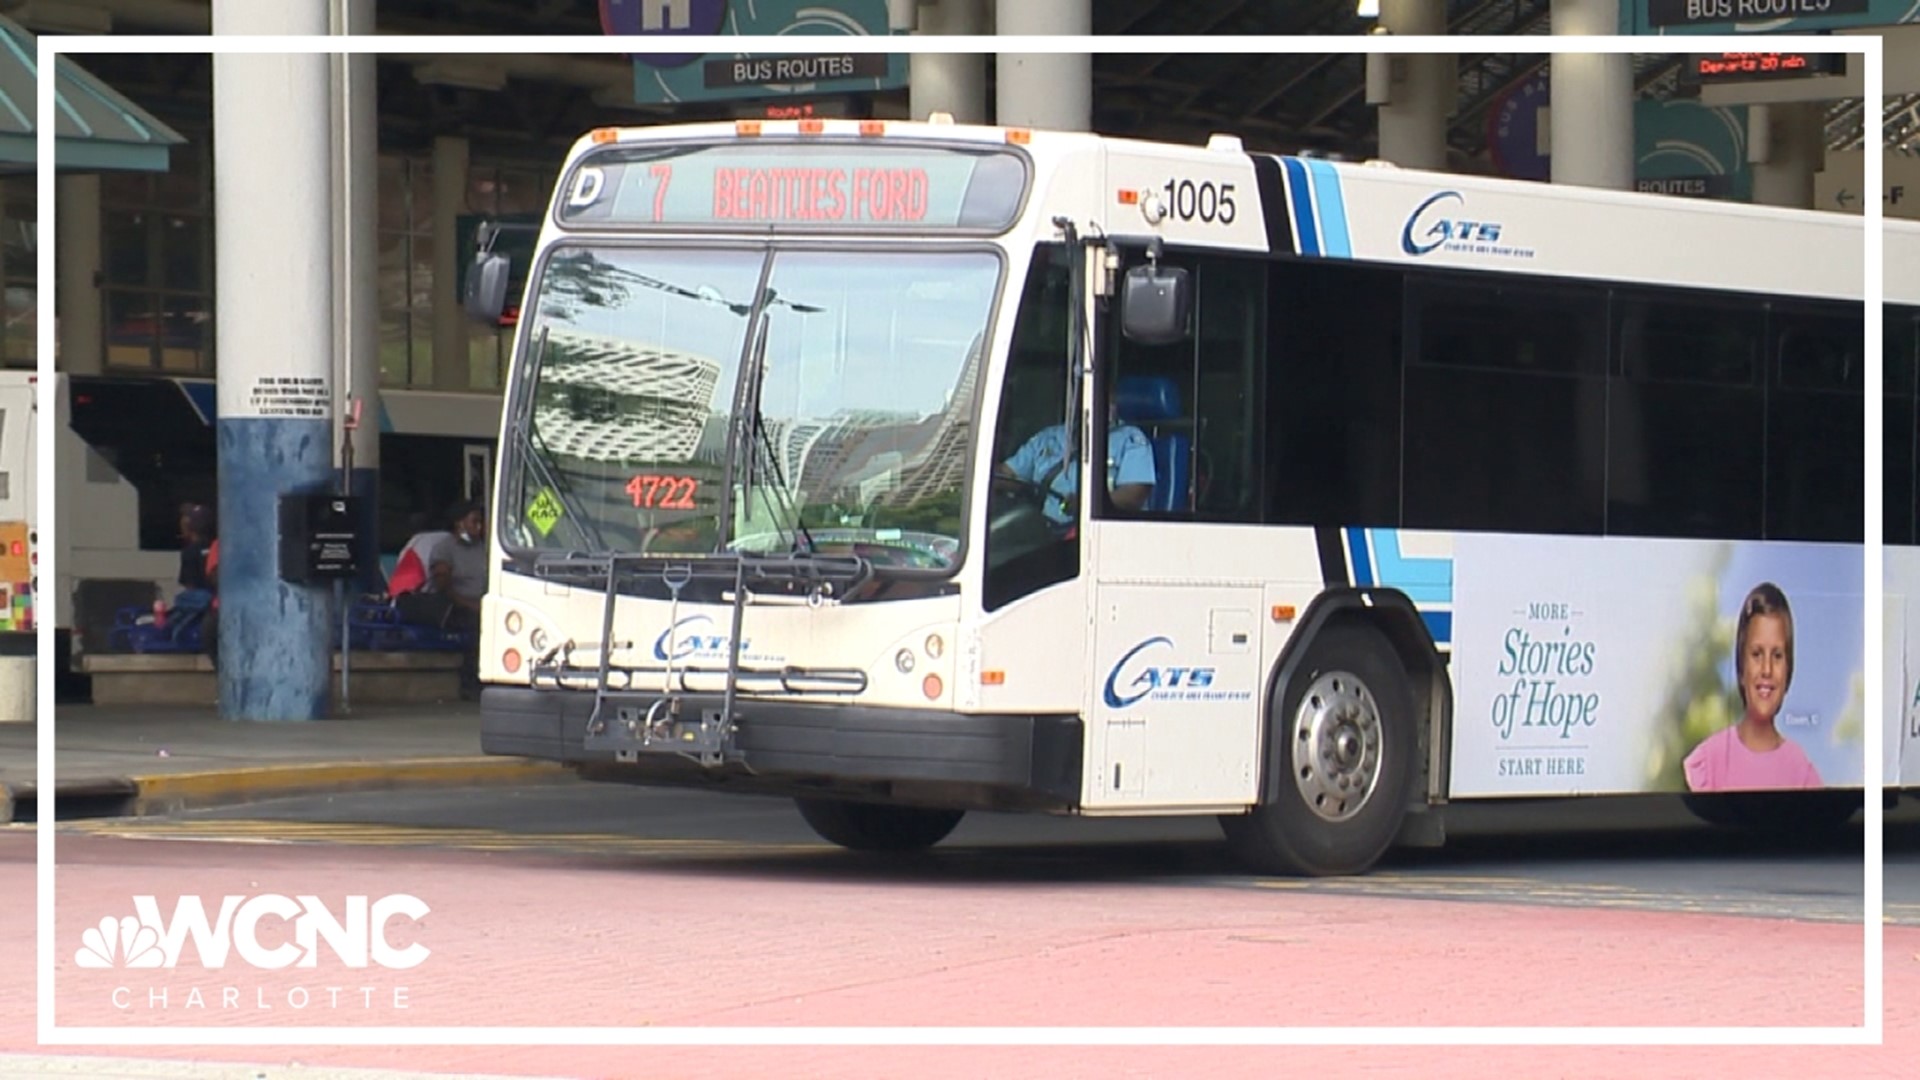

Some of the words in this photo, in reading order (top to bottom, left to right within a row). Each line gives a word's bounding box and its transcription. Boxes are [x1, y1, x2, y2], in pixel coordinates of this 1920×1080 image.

[1687, 0, 1732, 18] BUS
[1738, 0, 1830, 14] ROUTES
[734, 62, 772, 82] BUS
[777, 56, 854, 79] ROUTES
[569, 167, 605, 206] D
[650, 164, 672, 222] 7
[713, 167, 846, 219] BEATTIES
[852, 168, 929, 221] FORD
[1164, 178, 1236, 225] 1005
[1638, 179, 1706, 194] ROUTES
[1402, 190, 1502, 256] CATS
[625, 475, 697, 510] 4722
[1528, 603, 1569, 620] MORE
[1499, 625, 1596, 676] Stories
[1103, 636, 1216, 709] CATS
[1491, 678, 1527, 740] of
[1522, 680, 1600, 739] Hope
[1499, 758, 1543, 777] START
[1546, 757, 1585, 775] HERE
